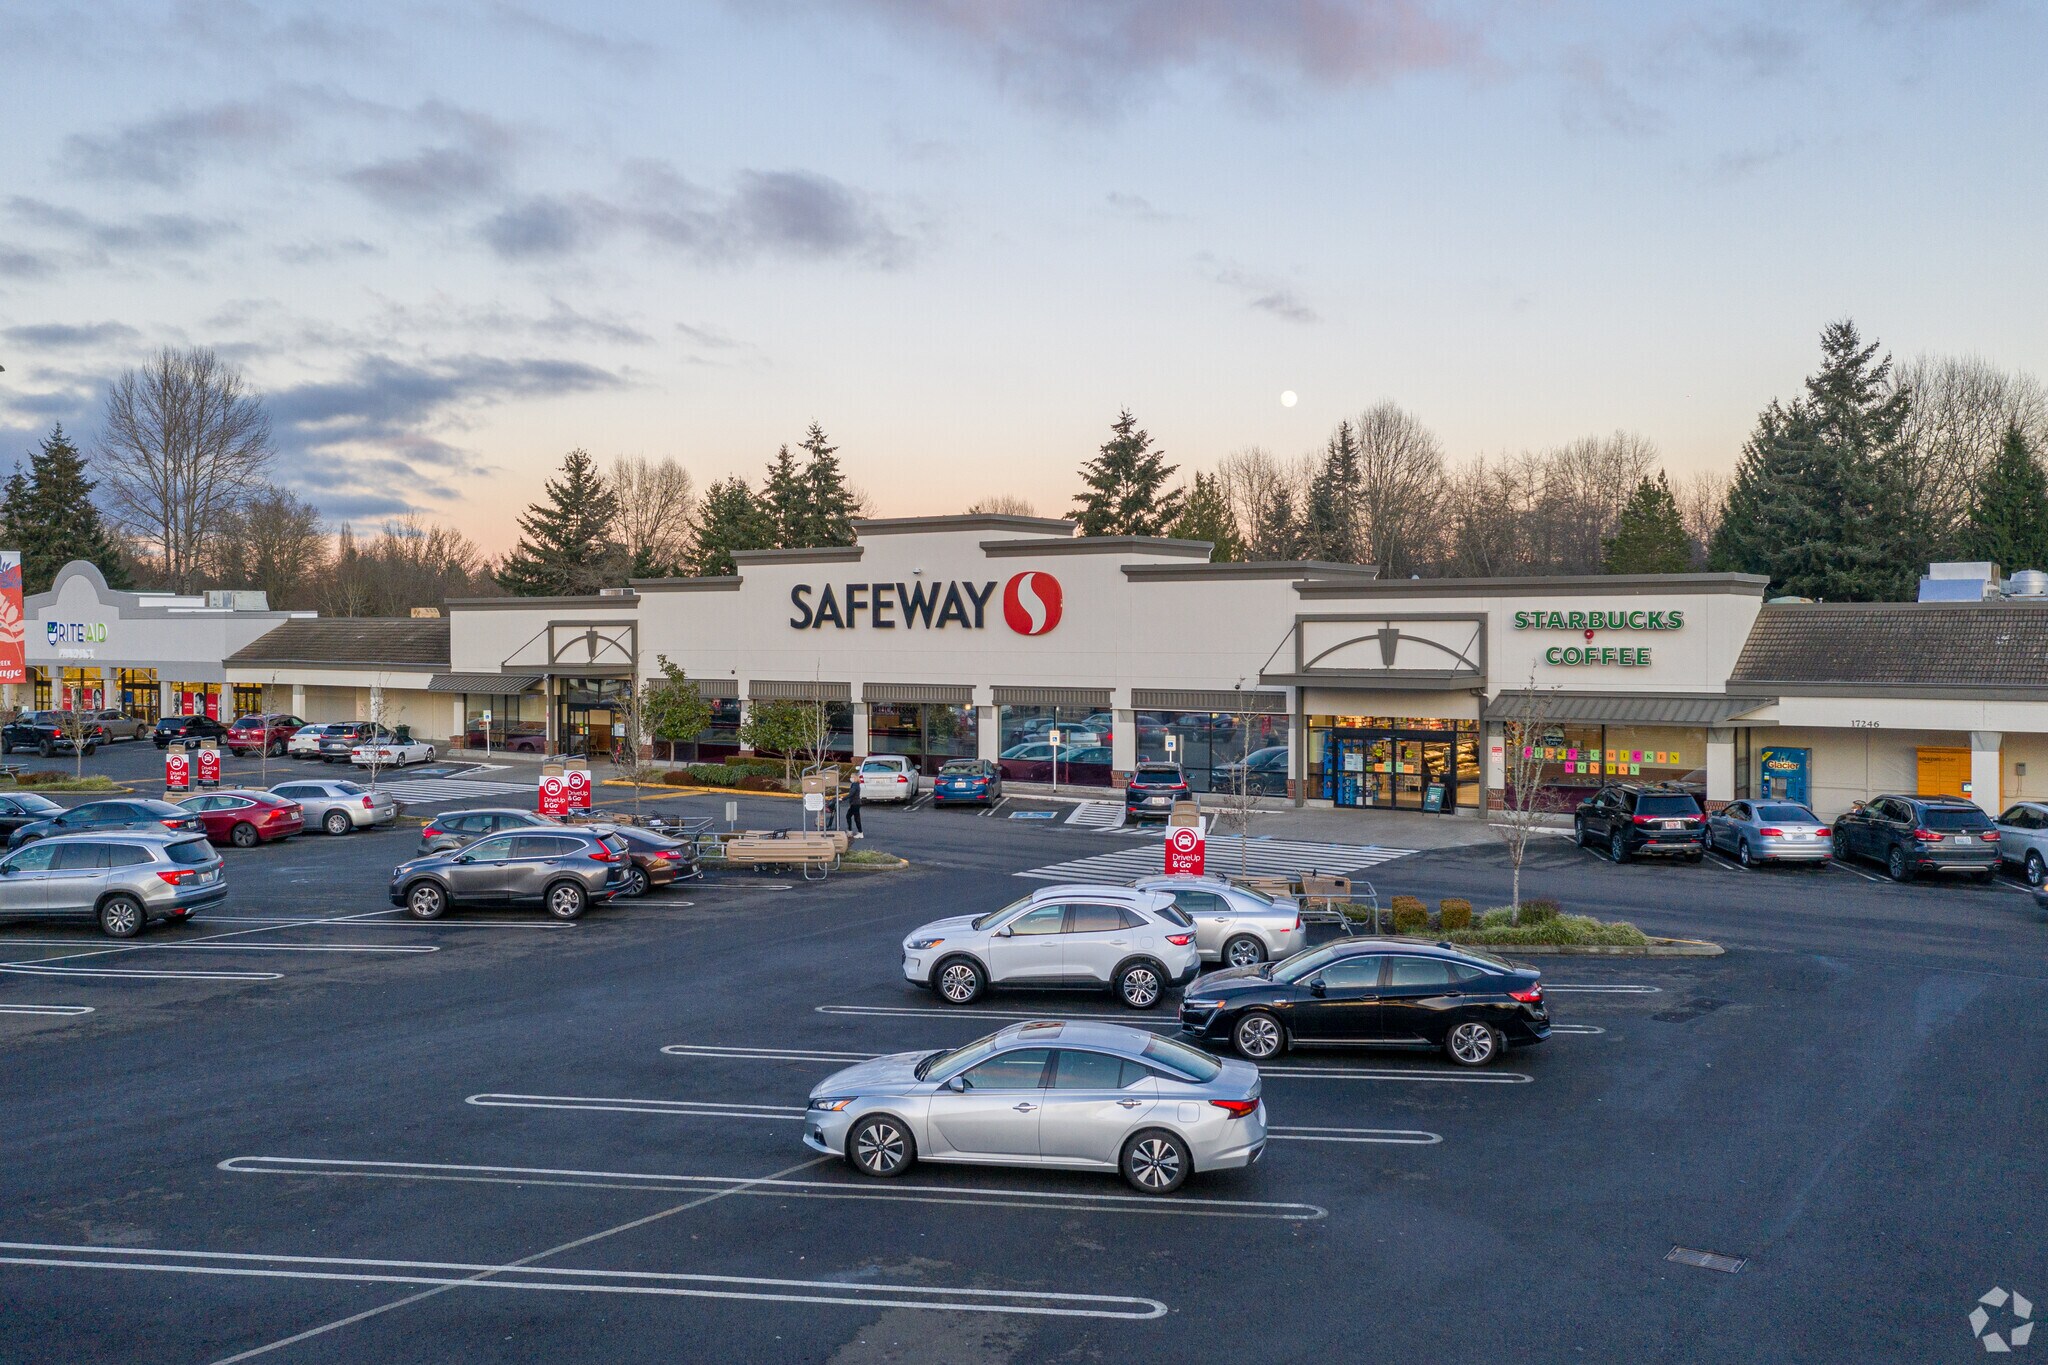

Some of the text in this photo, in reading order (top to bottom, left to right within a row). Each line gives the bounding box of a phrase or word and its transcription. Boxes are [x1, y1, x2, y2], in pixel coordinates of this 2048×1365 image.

[790, 581, 998, 630] SAFEWAY
[1513, 610, 1685, 630] STARBUCKS
[59, 623, 108, 642] RITE AID
[1545, 646, 1652, 666] COFFEE
[1850, 720, 1880, 728] 17246
[1592, 750, 1678, 761] CHICKEN
[1767, 760, 1800, 770] Glacier
[1172, 853, 1201, 863] DriveUp
